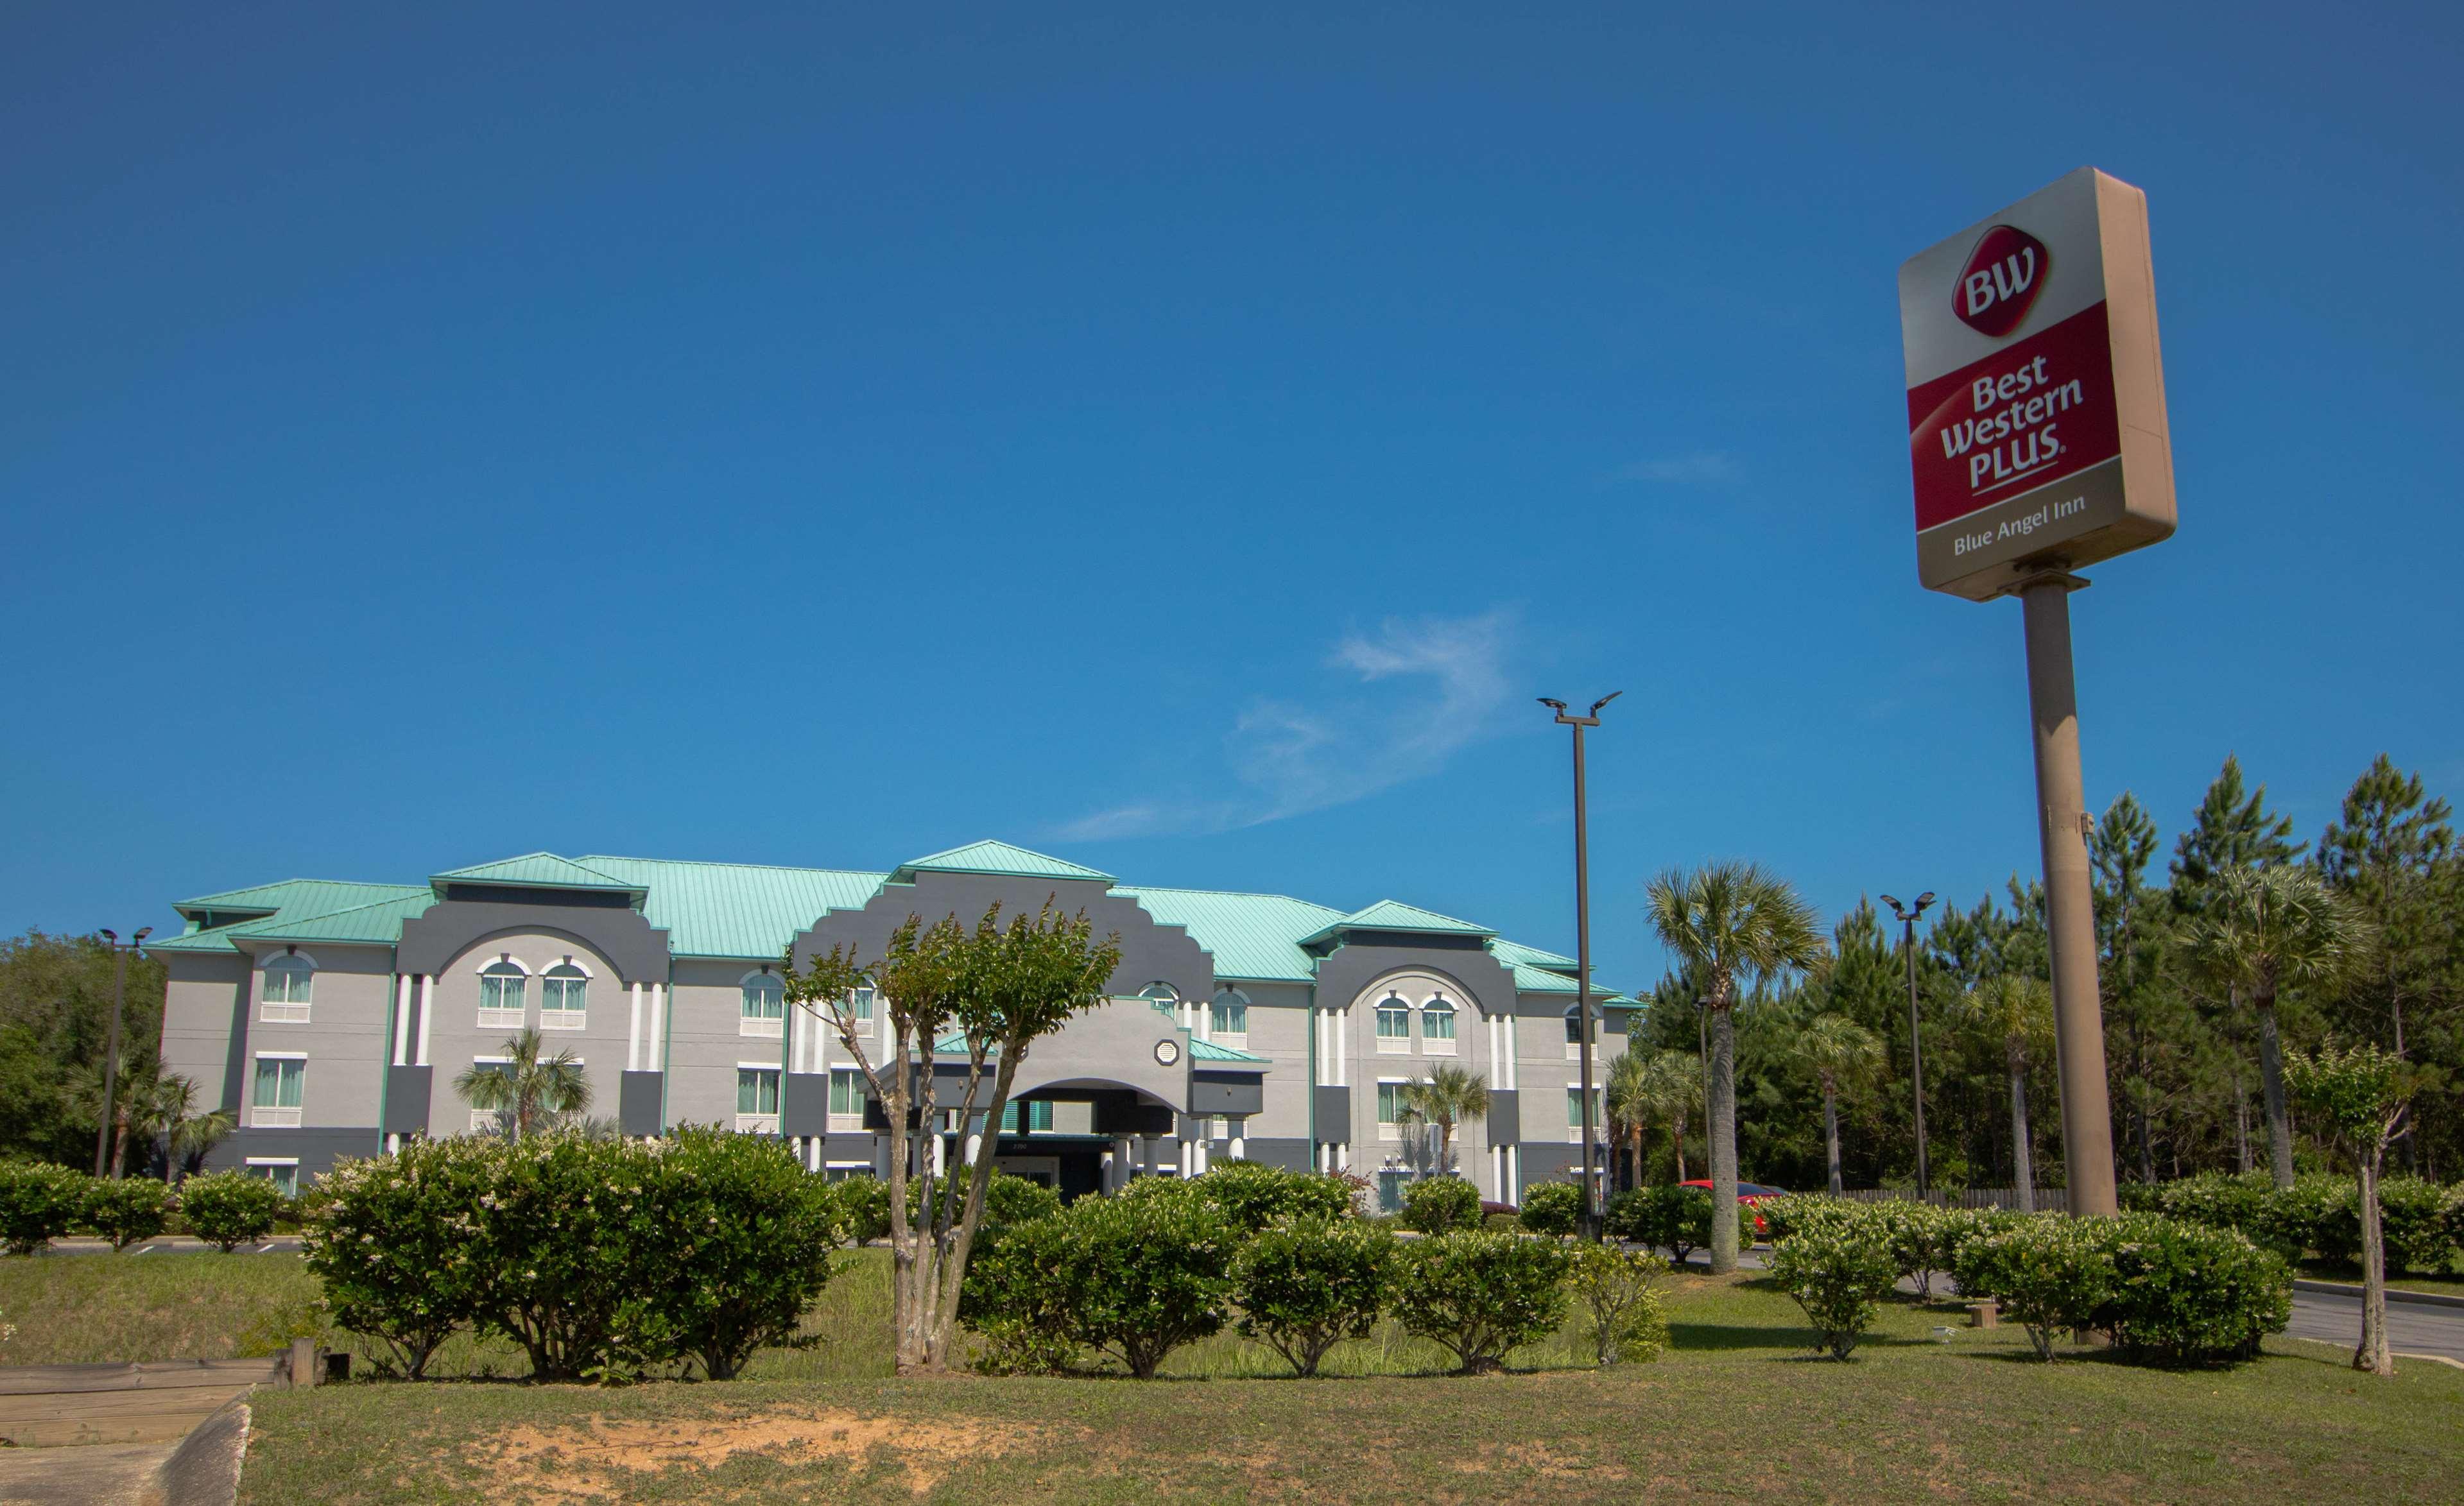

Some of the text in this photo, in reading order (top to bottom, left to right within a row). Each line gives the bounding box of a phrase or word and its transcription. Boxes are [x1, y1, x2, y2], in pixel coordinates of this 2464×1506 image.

[1965, 247, 2034, 316] BW
[1972, 355, 2048, 413] Best
[1940, 379, 2083, 459] Western
[1970, 423, 2060, 488] PLUS
[1954, 496, 2085, 562] Blue Angel Inn
